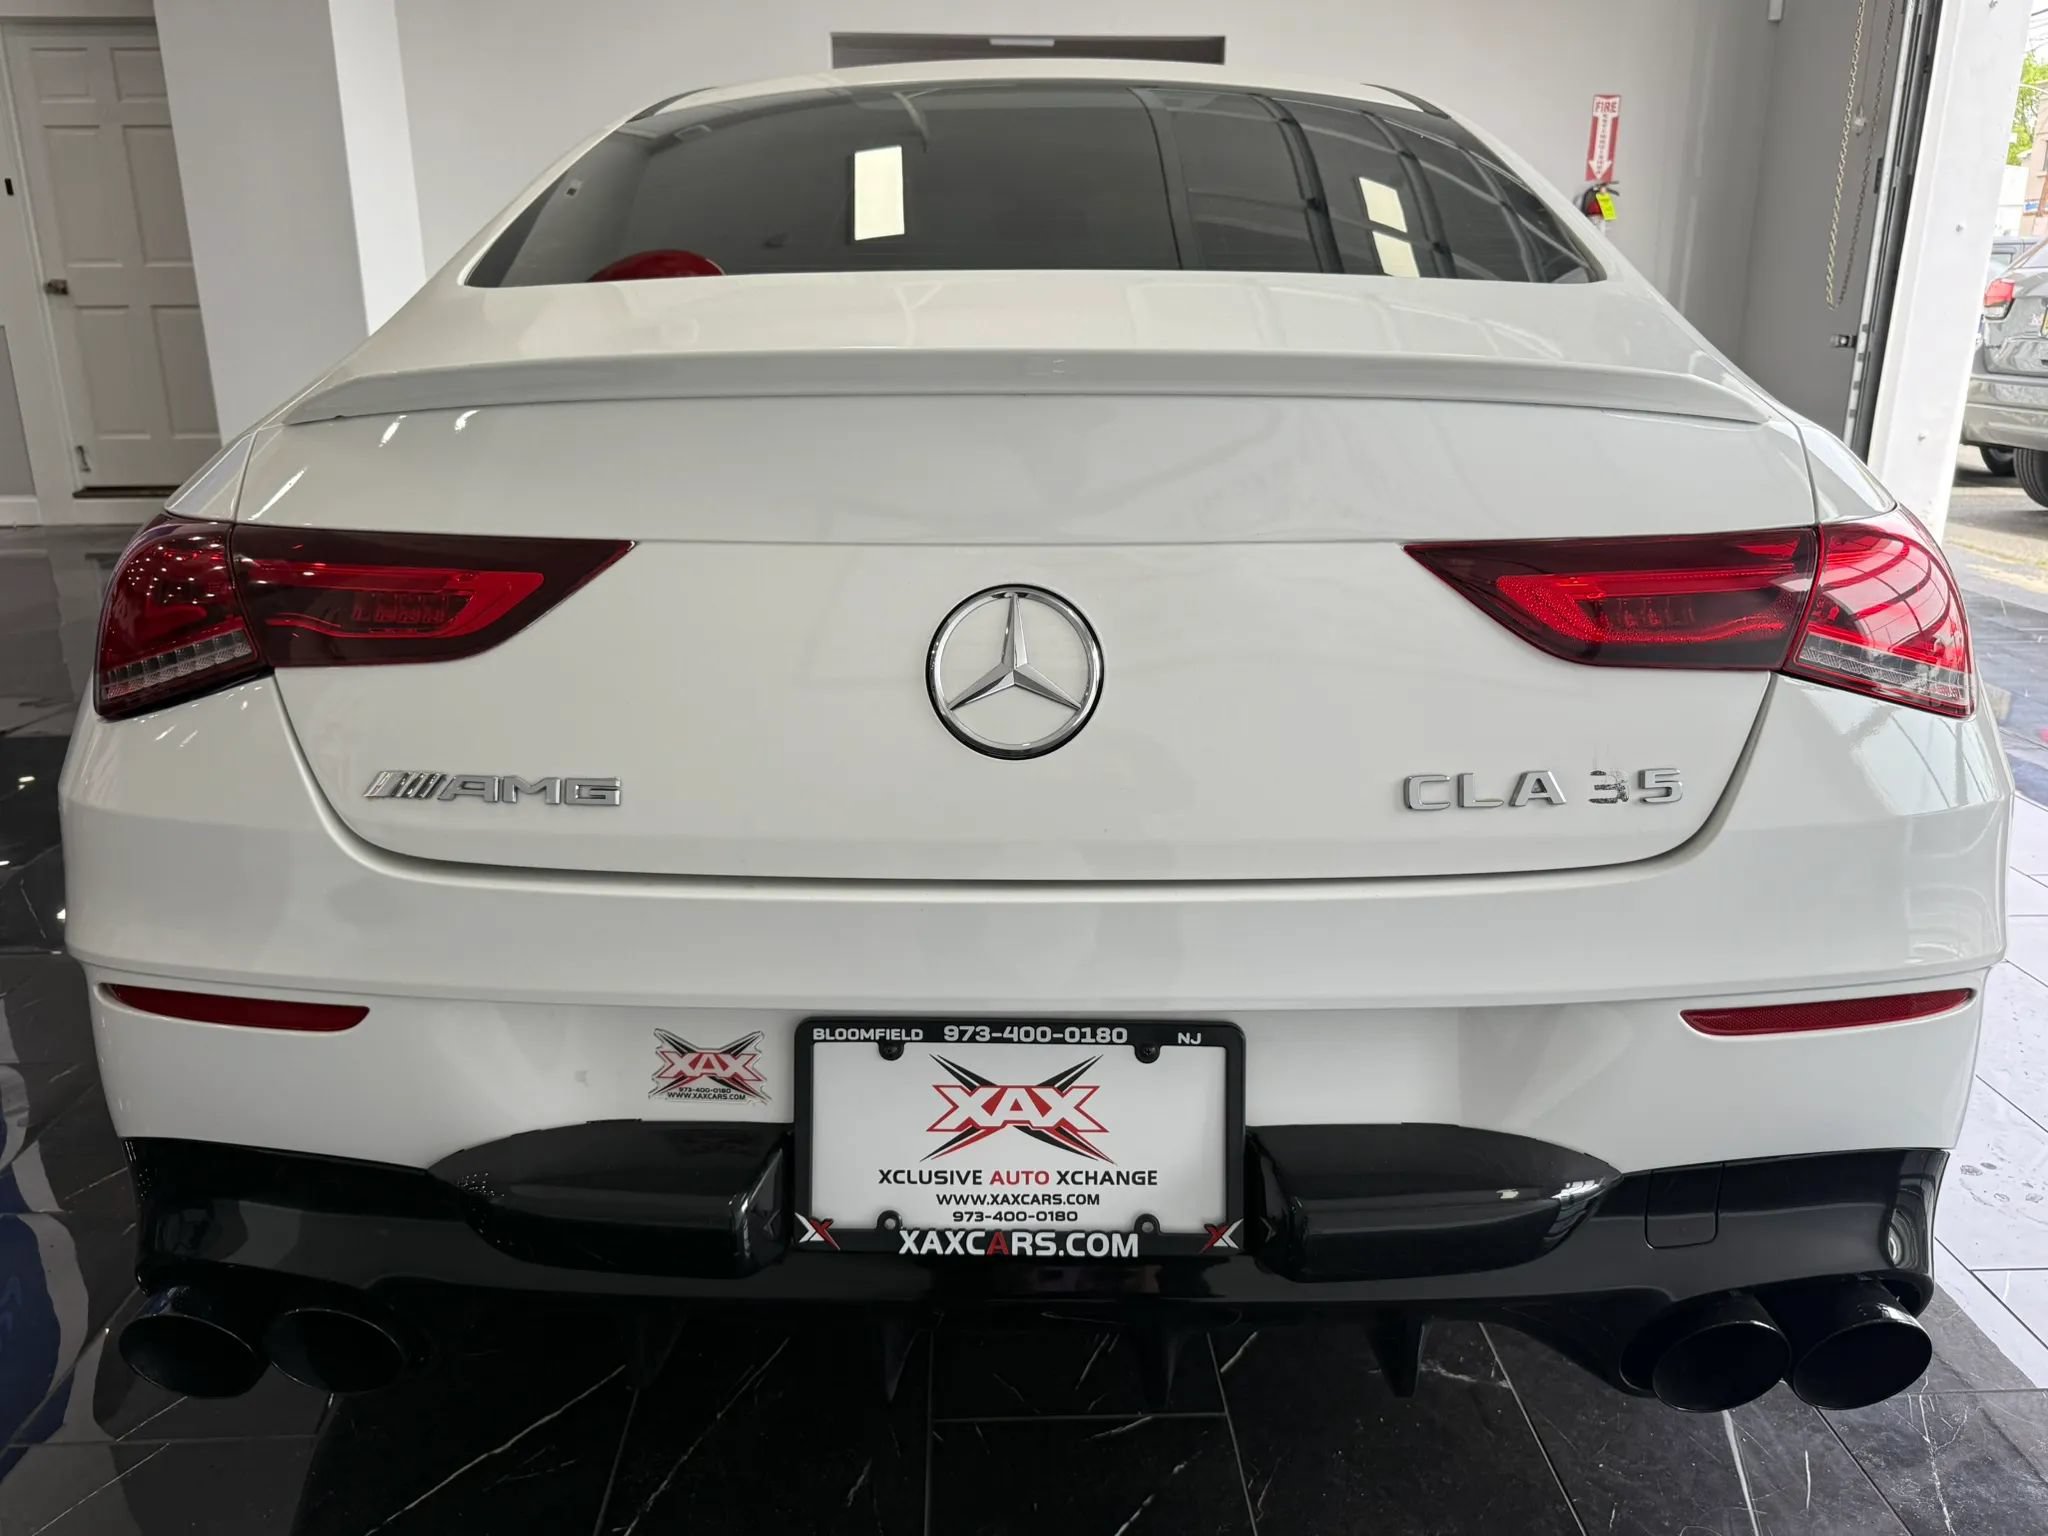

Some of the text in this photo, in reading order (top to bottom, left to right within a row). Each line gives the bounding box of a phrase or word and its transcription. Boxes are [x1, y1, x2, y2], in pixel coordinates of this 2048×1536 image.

[1595, 101, 1617, 113] FIRE
[437, 774, 622, 807] AMG
[1402, 767, 1684, 811] CLA 35
[812, 1028, 924, 1041] BLOOMFIELD
[943, 1025, 1128, 1044] 973-400-0180
[1177, 1032, 1203, 1045] NJ
[657, 1051, 763, 1082] XAX
[667, 1091, 747, 1101] WWW.XAXCARS.COM
[926, 1085, 1110, 1132] XAX
[878, 1169, 1158, 1186] XCLUSIVE AUTO XCHANGE
[936, 1192, 1100, 1206] WWW.XAXCARS.COM
[952, 1210, 1078, 1223] 973-400-0180
[898, 1229, 1140, 1258] XAXCARS.COM
